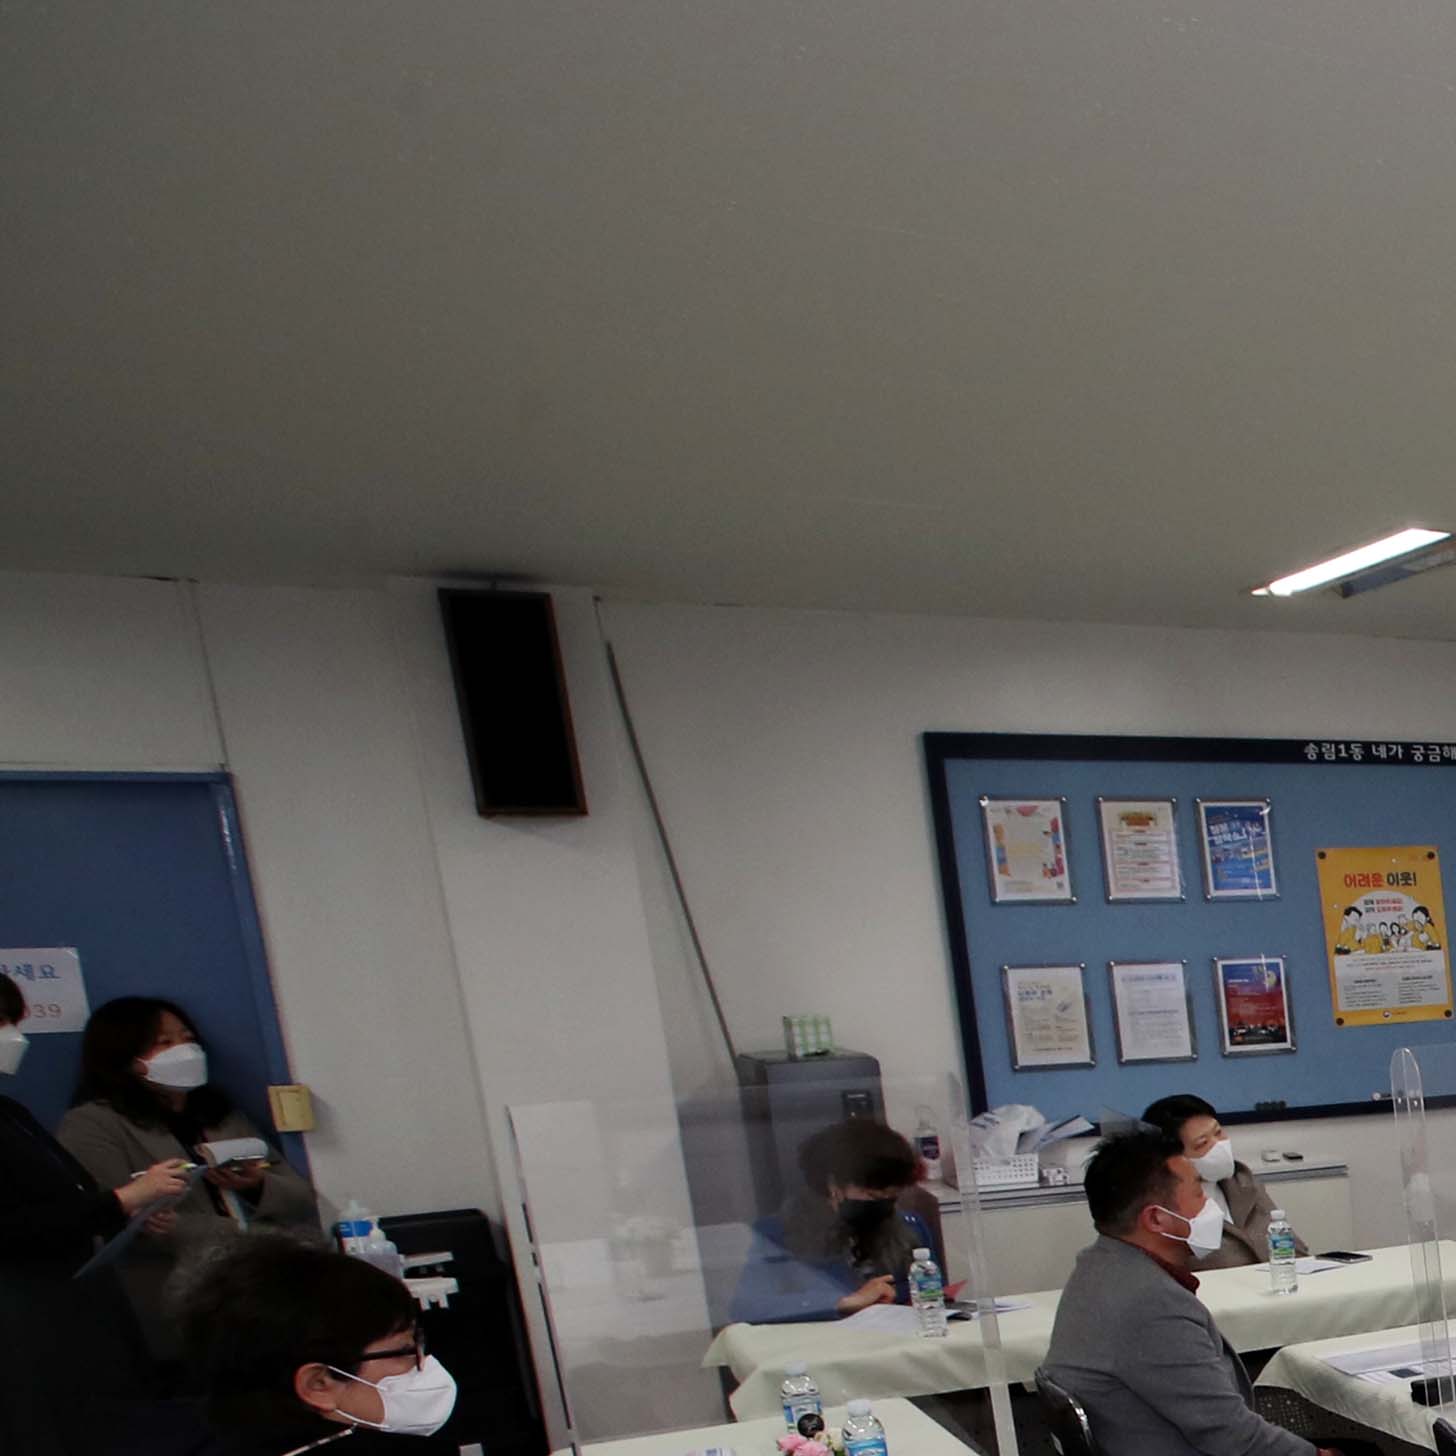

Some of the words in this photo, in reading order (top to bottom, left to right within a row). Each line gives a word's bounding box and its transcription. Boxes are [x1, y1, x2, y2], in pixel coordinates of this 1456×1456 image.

[1304, 743, 1365, 761] 송림1동
[1371, 744, 1403, 759] 네가
[1343, 872, 1385, 888] 어려운
